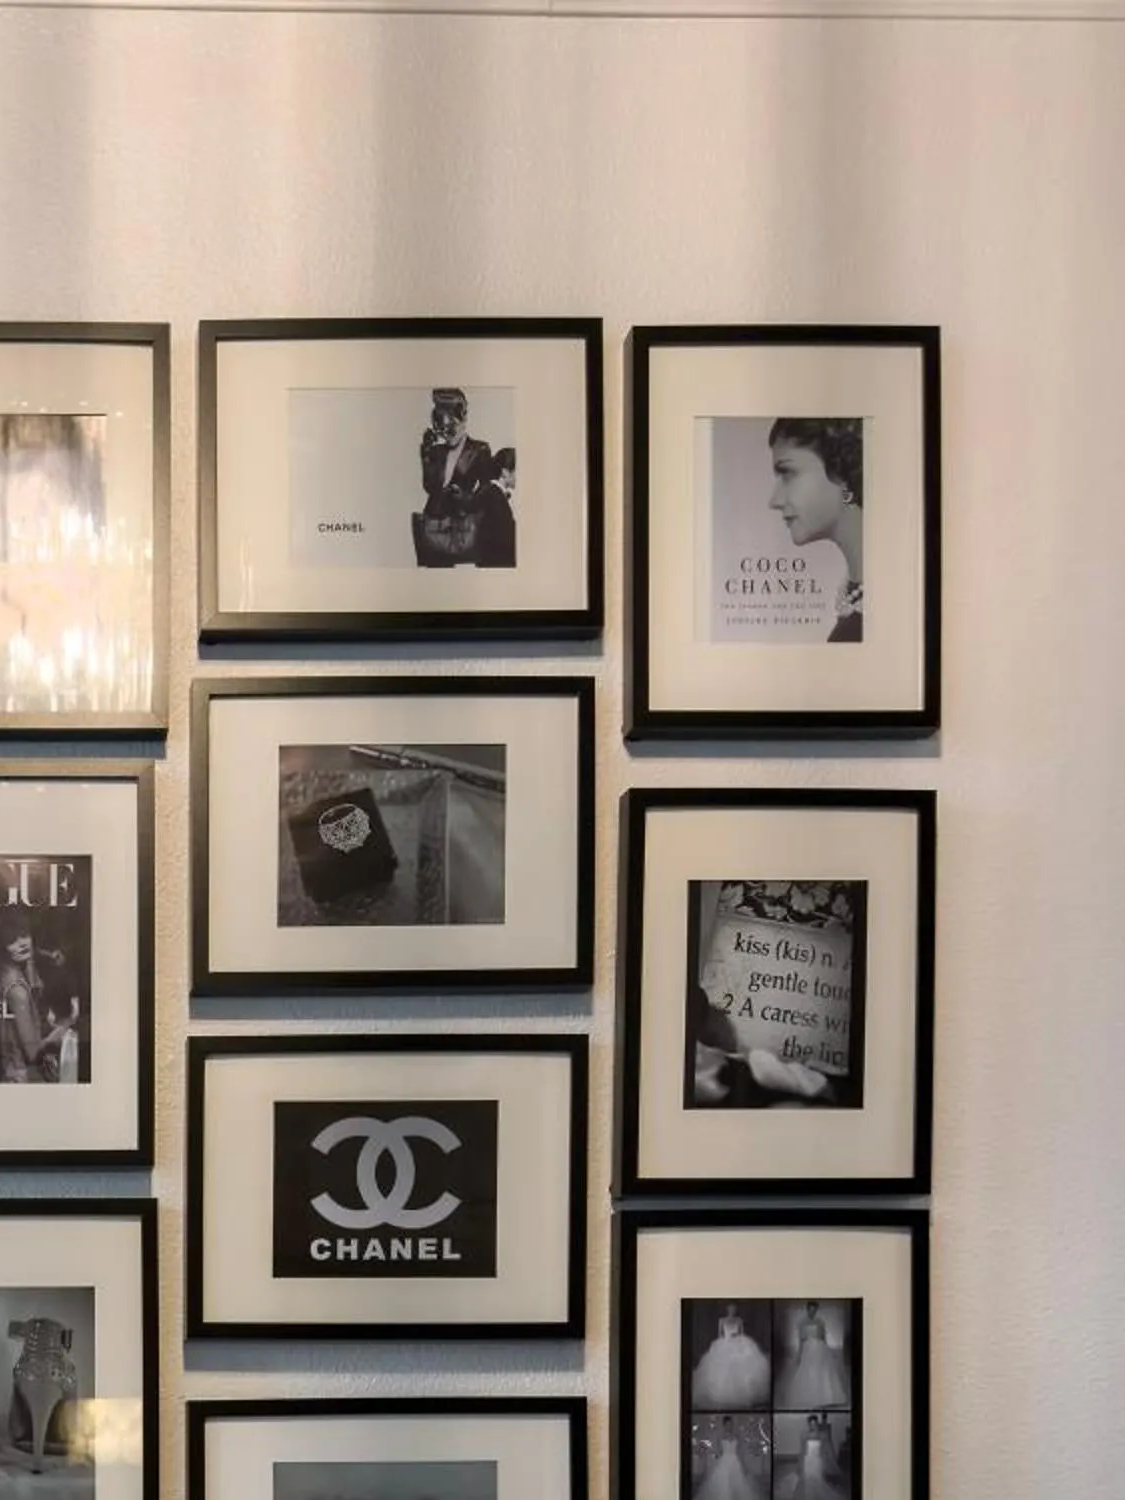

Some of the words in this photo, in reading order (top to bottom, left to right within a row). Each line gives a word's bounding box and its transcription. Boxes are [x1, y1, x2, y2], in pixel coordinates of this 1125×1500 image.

[317, 522, 365, 533] CHANEL
[740, 557, 806, 573] COCO
[724, 579, 822, 594] CHANEL
[733, 931, 771, 957] kiss
[775, 939, 816, 968] (kis)
[748, 970, 808, 994] gentle
[722, 993, 735, 1016] 2
[738, 997, 755, 1018] A
[760, 1004, 819, 1029] caress
[781, 1034, 814, 1061] the
[310, 1238, 462, 1261] CHANEL
